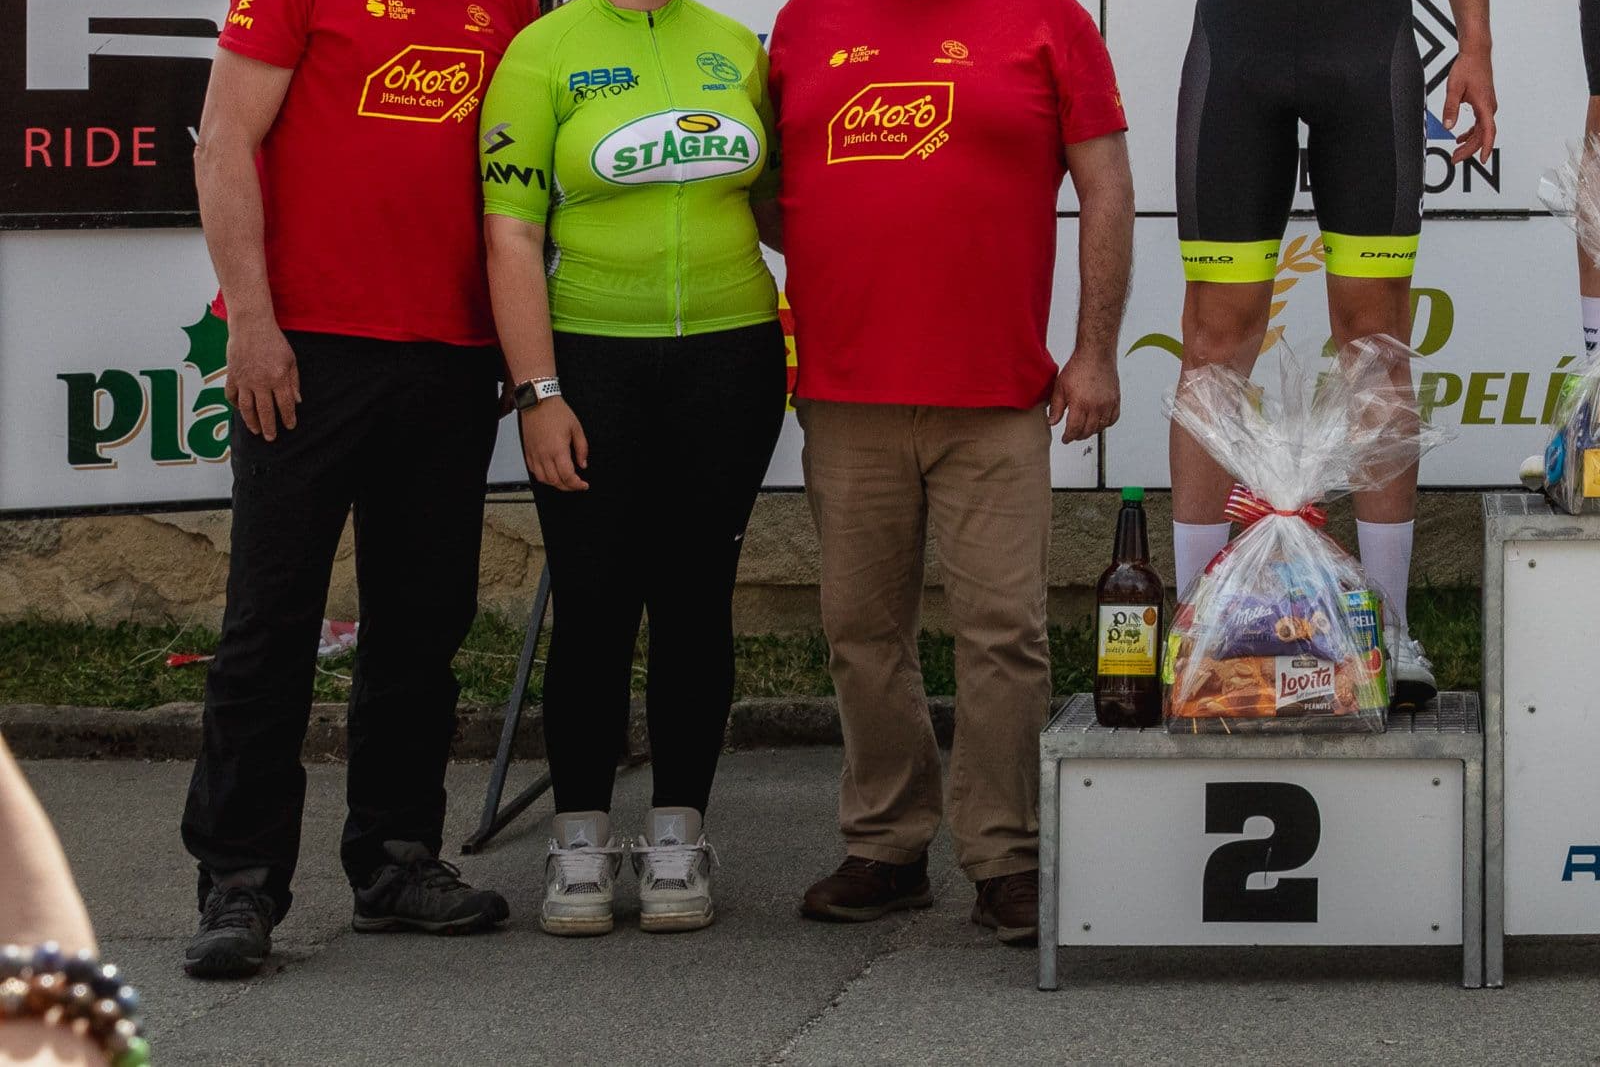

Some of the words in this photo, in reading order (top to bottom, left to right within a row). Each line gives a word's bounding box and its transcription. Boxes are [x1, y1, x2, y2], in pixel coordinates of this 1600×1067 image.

[569, 66, 633, 92] RBB
[452, 96, 480, 123] 2025
[25, 127, 157, 167] RIDE
[612, 130, 750, 174] STAGRA
[917, 130, 949, 160] 2025
[1181, 255, 1234, 263] NIELO
[1360, 251, 1417, 259] DANIE
[1232, 606, 1274, 624] Milka
[1350, 616, 1376, 627] RELL
[1304, 702, 1331, 710] PEANUTS
[1202, 781, 1321, 923] 2
